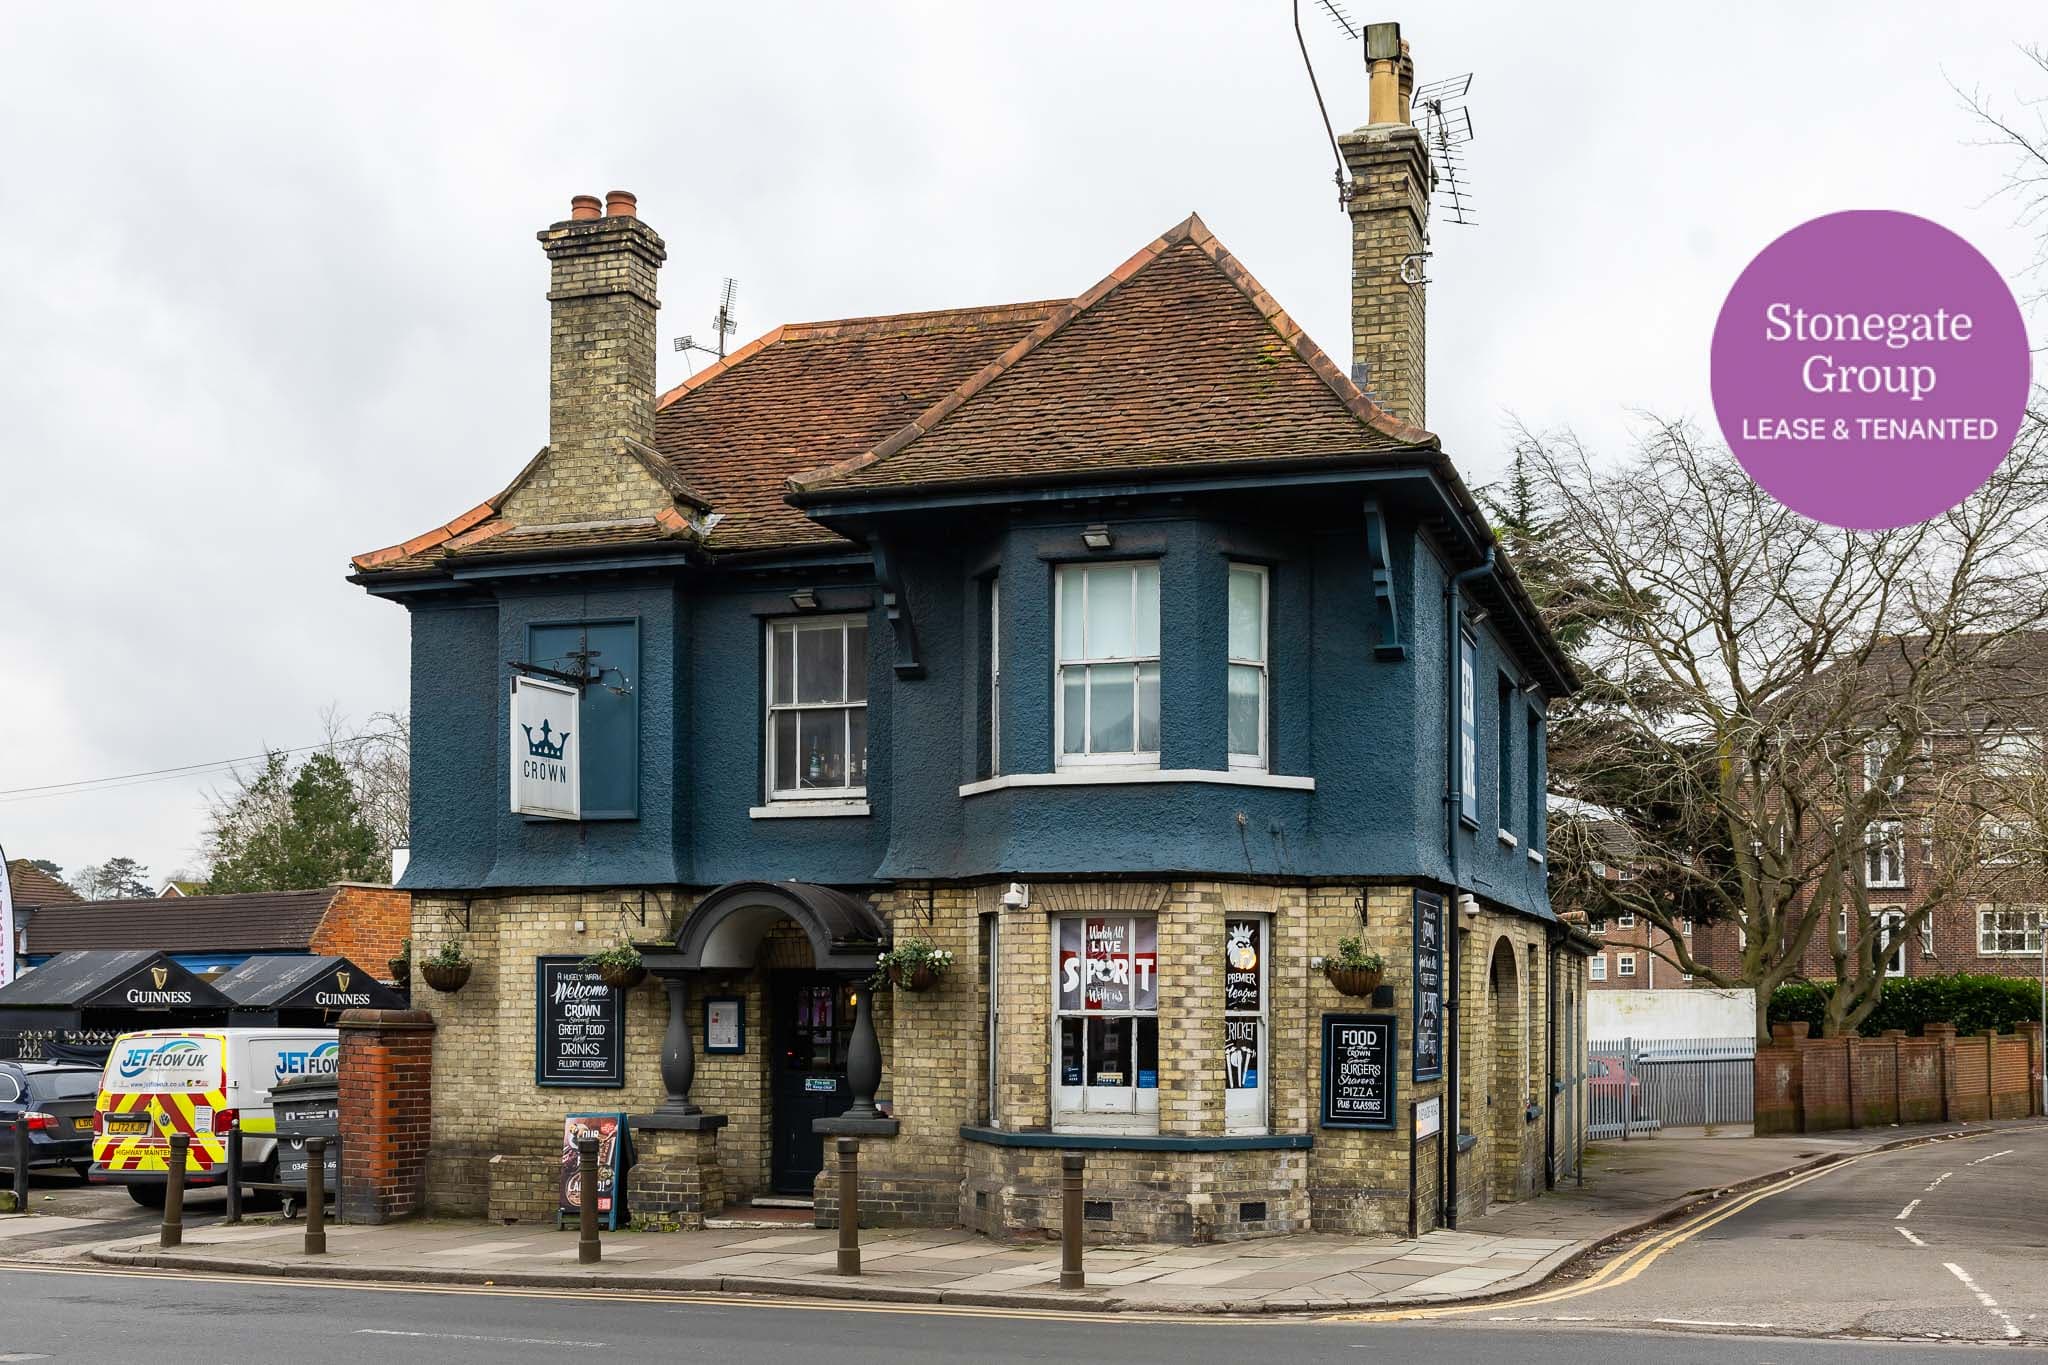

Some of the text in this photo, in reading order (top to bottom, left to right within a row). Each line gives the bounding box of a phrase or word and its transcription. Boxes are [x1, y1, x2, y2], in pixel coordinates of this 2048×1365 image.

[523, 760, 567, 784] CROWN
[1091, 941, 1121, 953] LIVE
[1063, 957, 1154, 993] SPORT
[1227, 973, 1257, 986] PREMIER
[126, 989, 192, 1004] GUINNESS
[315, 991, 370, 1005] GUINNESS
[550, 981, 609, 1004] Welcome
[564, 1004, 601, 1018] CROWN
[558, 1023, 606, 1036] GREAT FOOD
[1341, 1029, 1377, 1046] FOOD
[561, 1042, 600, 1055] DRINKS
[1347, 1050, 1371, 1058] CROWN
[187, 1054, 209, 1067] UK
[1341, 1063, 1381, 1077] BURGERS
[1342, 1086, 1374, 1097] PIZZA
[1337, 1099, 1381, 1110] PUB CLASSICS
[144, 1149, 191, 1157] MAINTEE
